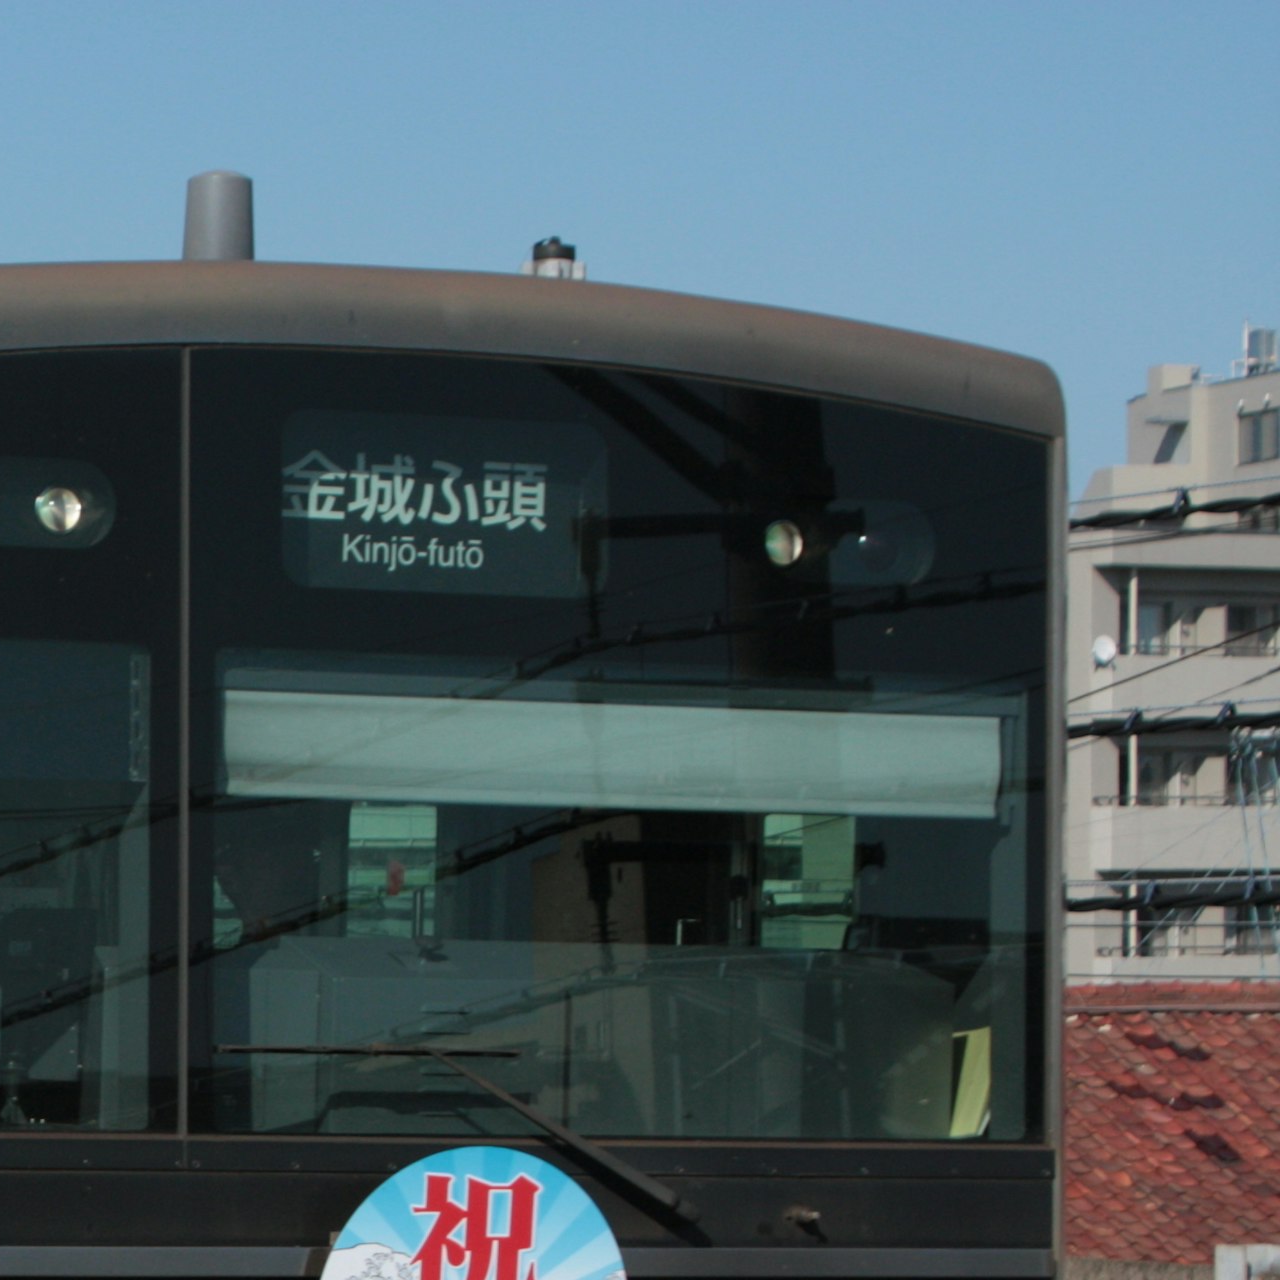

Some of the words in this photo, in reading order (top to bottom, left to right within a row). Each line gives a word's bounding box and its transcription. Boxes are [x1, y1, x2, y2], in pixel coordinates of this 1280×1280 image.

[282, 450, 548, 532] 金城ふ頭
[342, 533, 485, 571] Kinjō-futō
